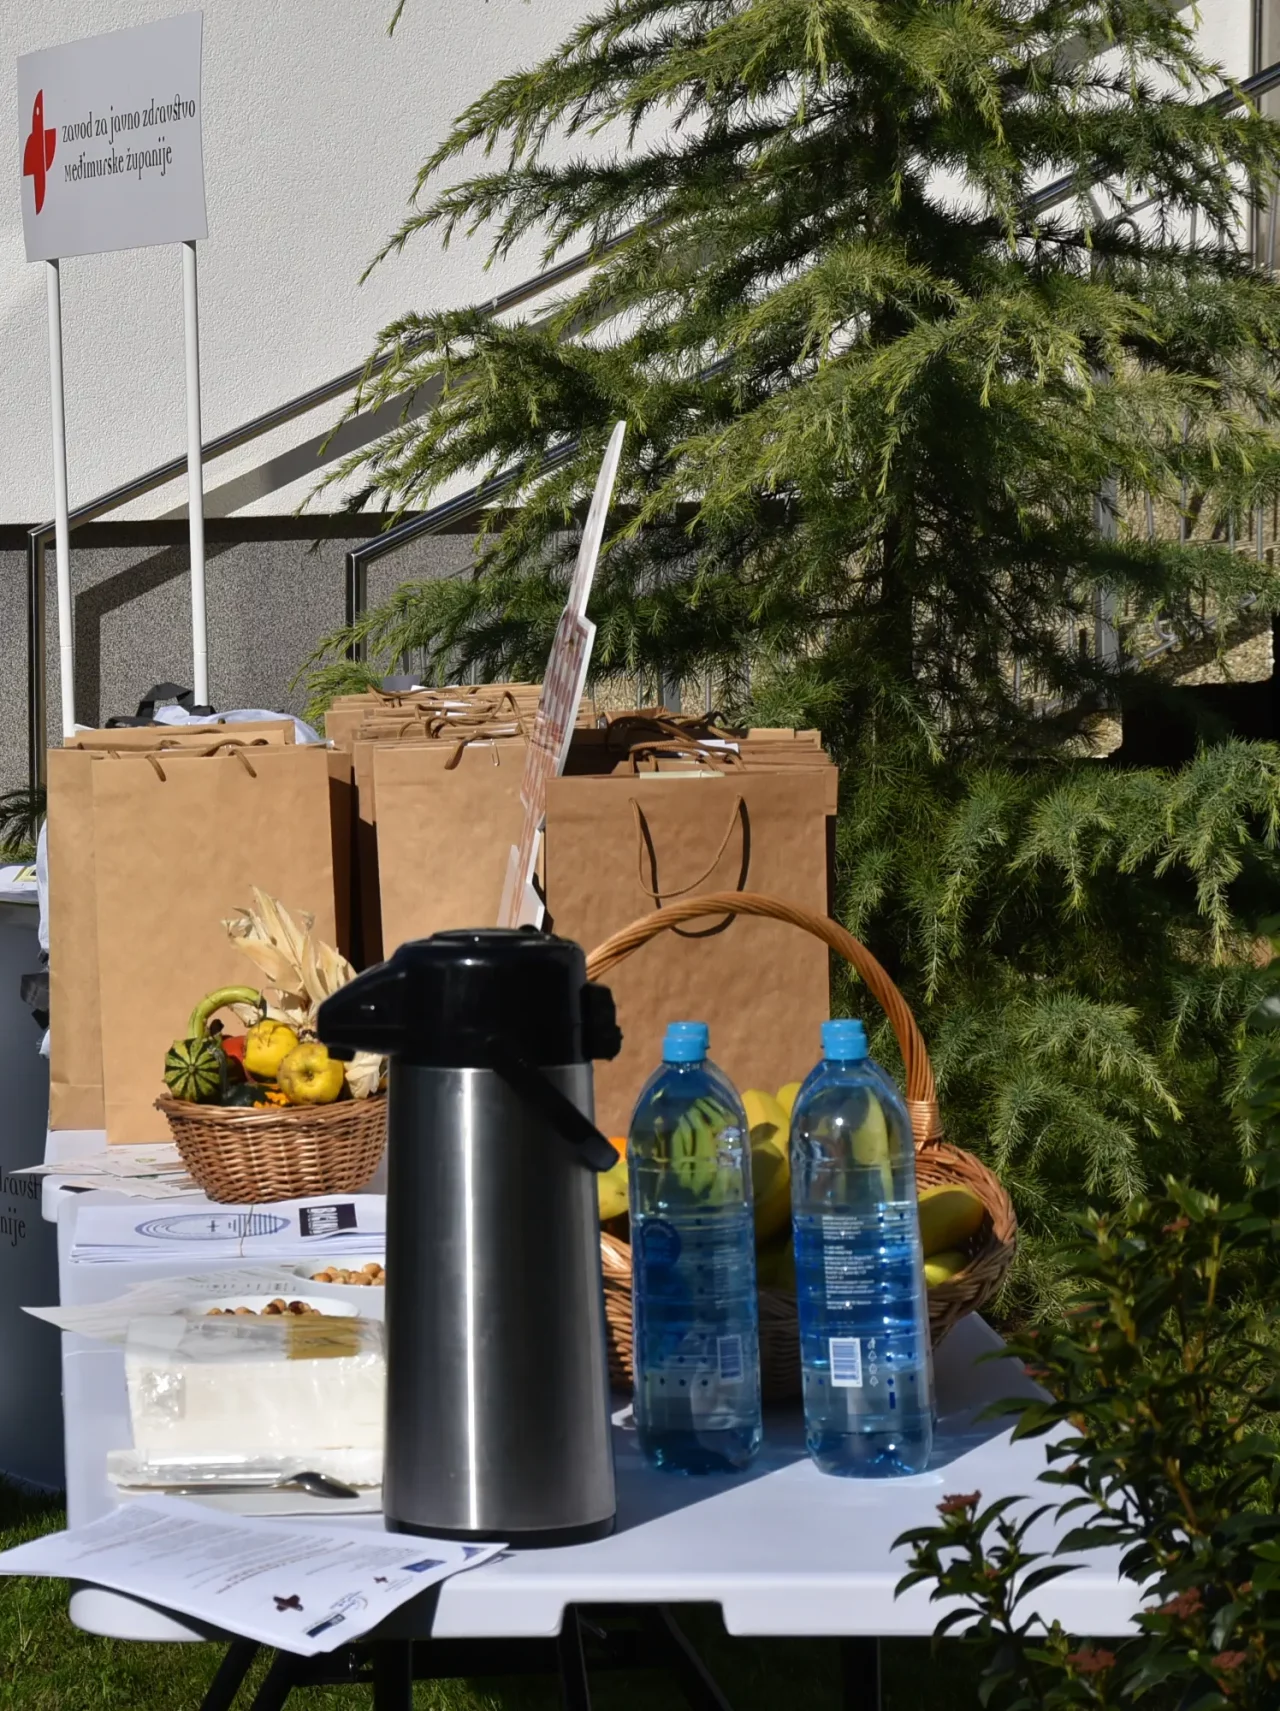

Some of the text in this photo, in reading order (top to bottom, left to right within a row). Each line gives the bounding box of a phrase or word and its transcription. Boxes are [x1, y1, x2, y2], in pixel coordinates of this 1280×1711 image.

[62, 93, 196, 145] zavod za javno zdravstvo
[126, 136, 173, 180] županije
